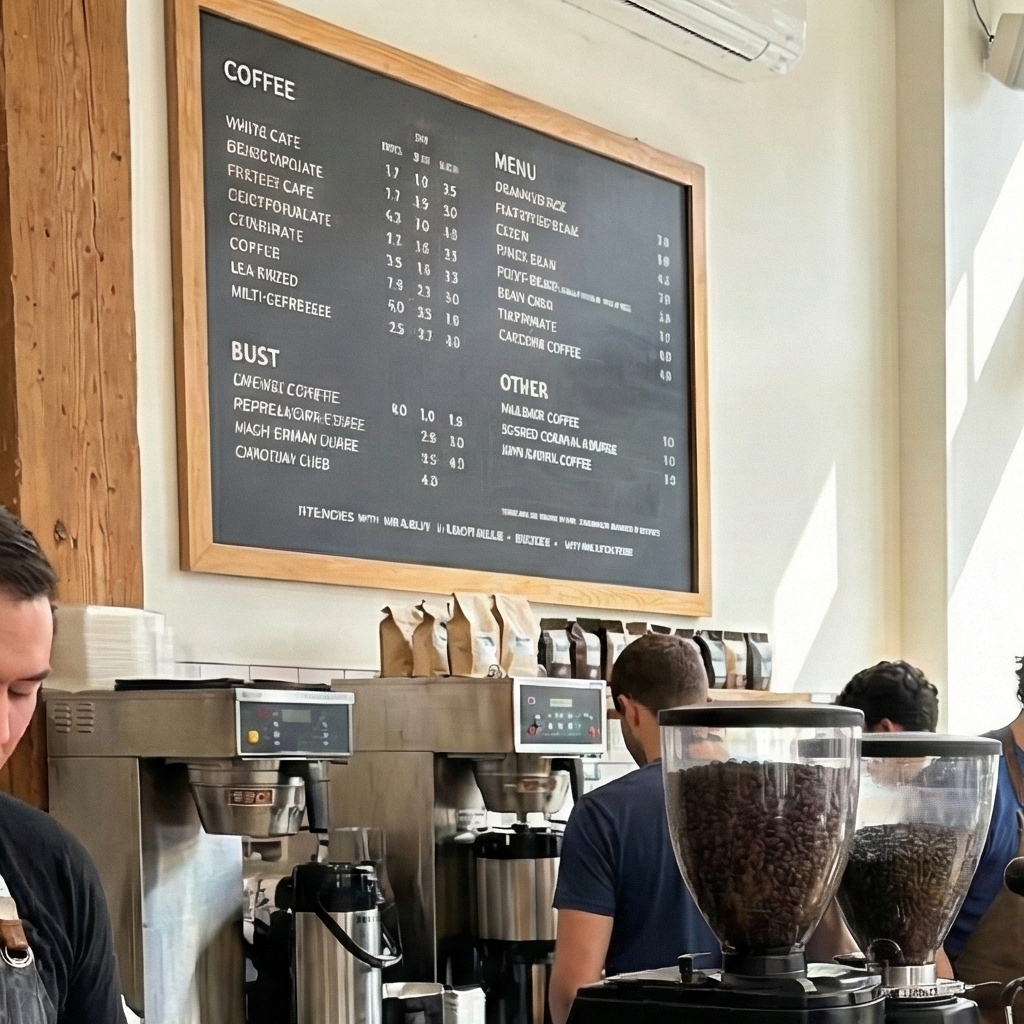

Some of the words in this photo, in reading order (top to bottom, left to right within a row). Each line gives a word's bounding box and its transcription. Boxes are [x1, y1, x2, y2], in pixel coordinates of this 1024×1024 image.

[223, 59, 296, 101] COFFEE
[269, 129, 301, 150] CAFE
[494, 151, 536, 181] MENU
[283, 180, 315, 200] CAFE
[231, 340, 280, 368] BUST
[546, 340, 582, 360] COFFEE
[500, 373, 549, 400] OTHER
[547, 411, 580, 429] COFFEE
